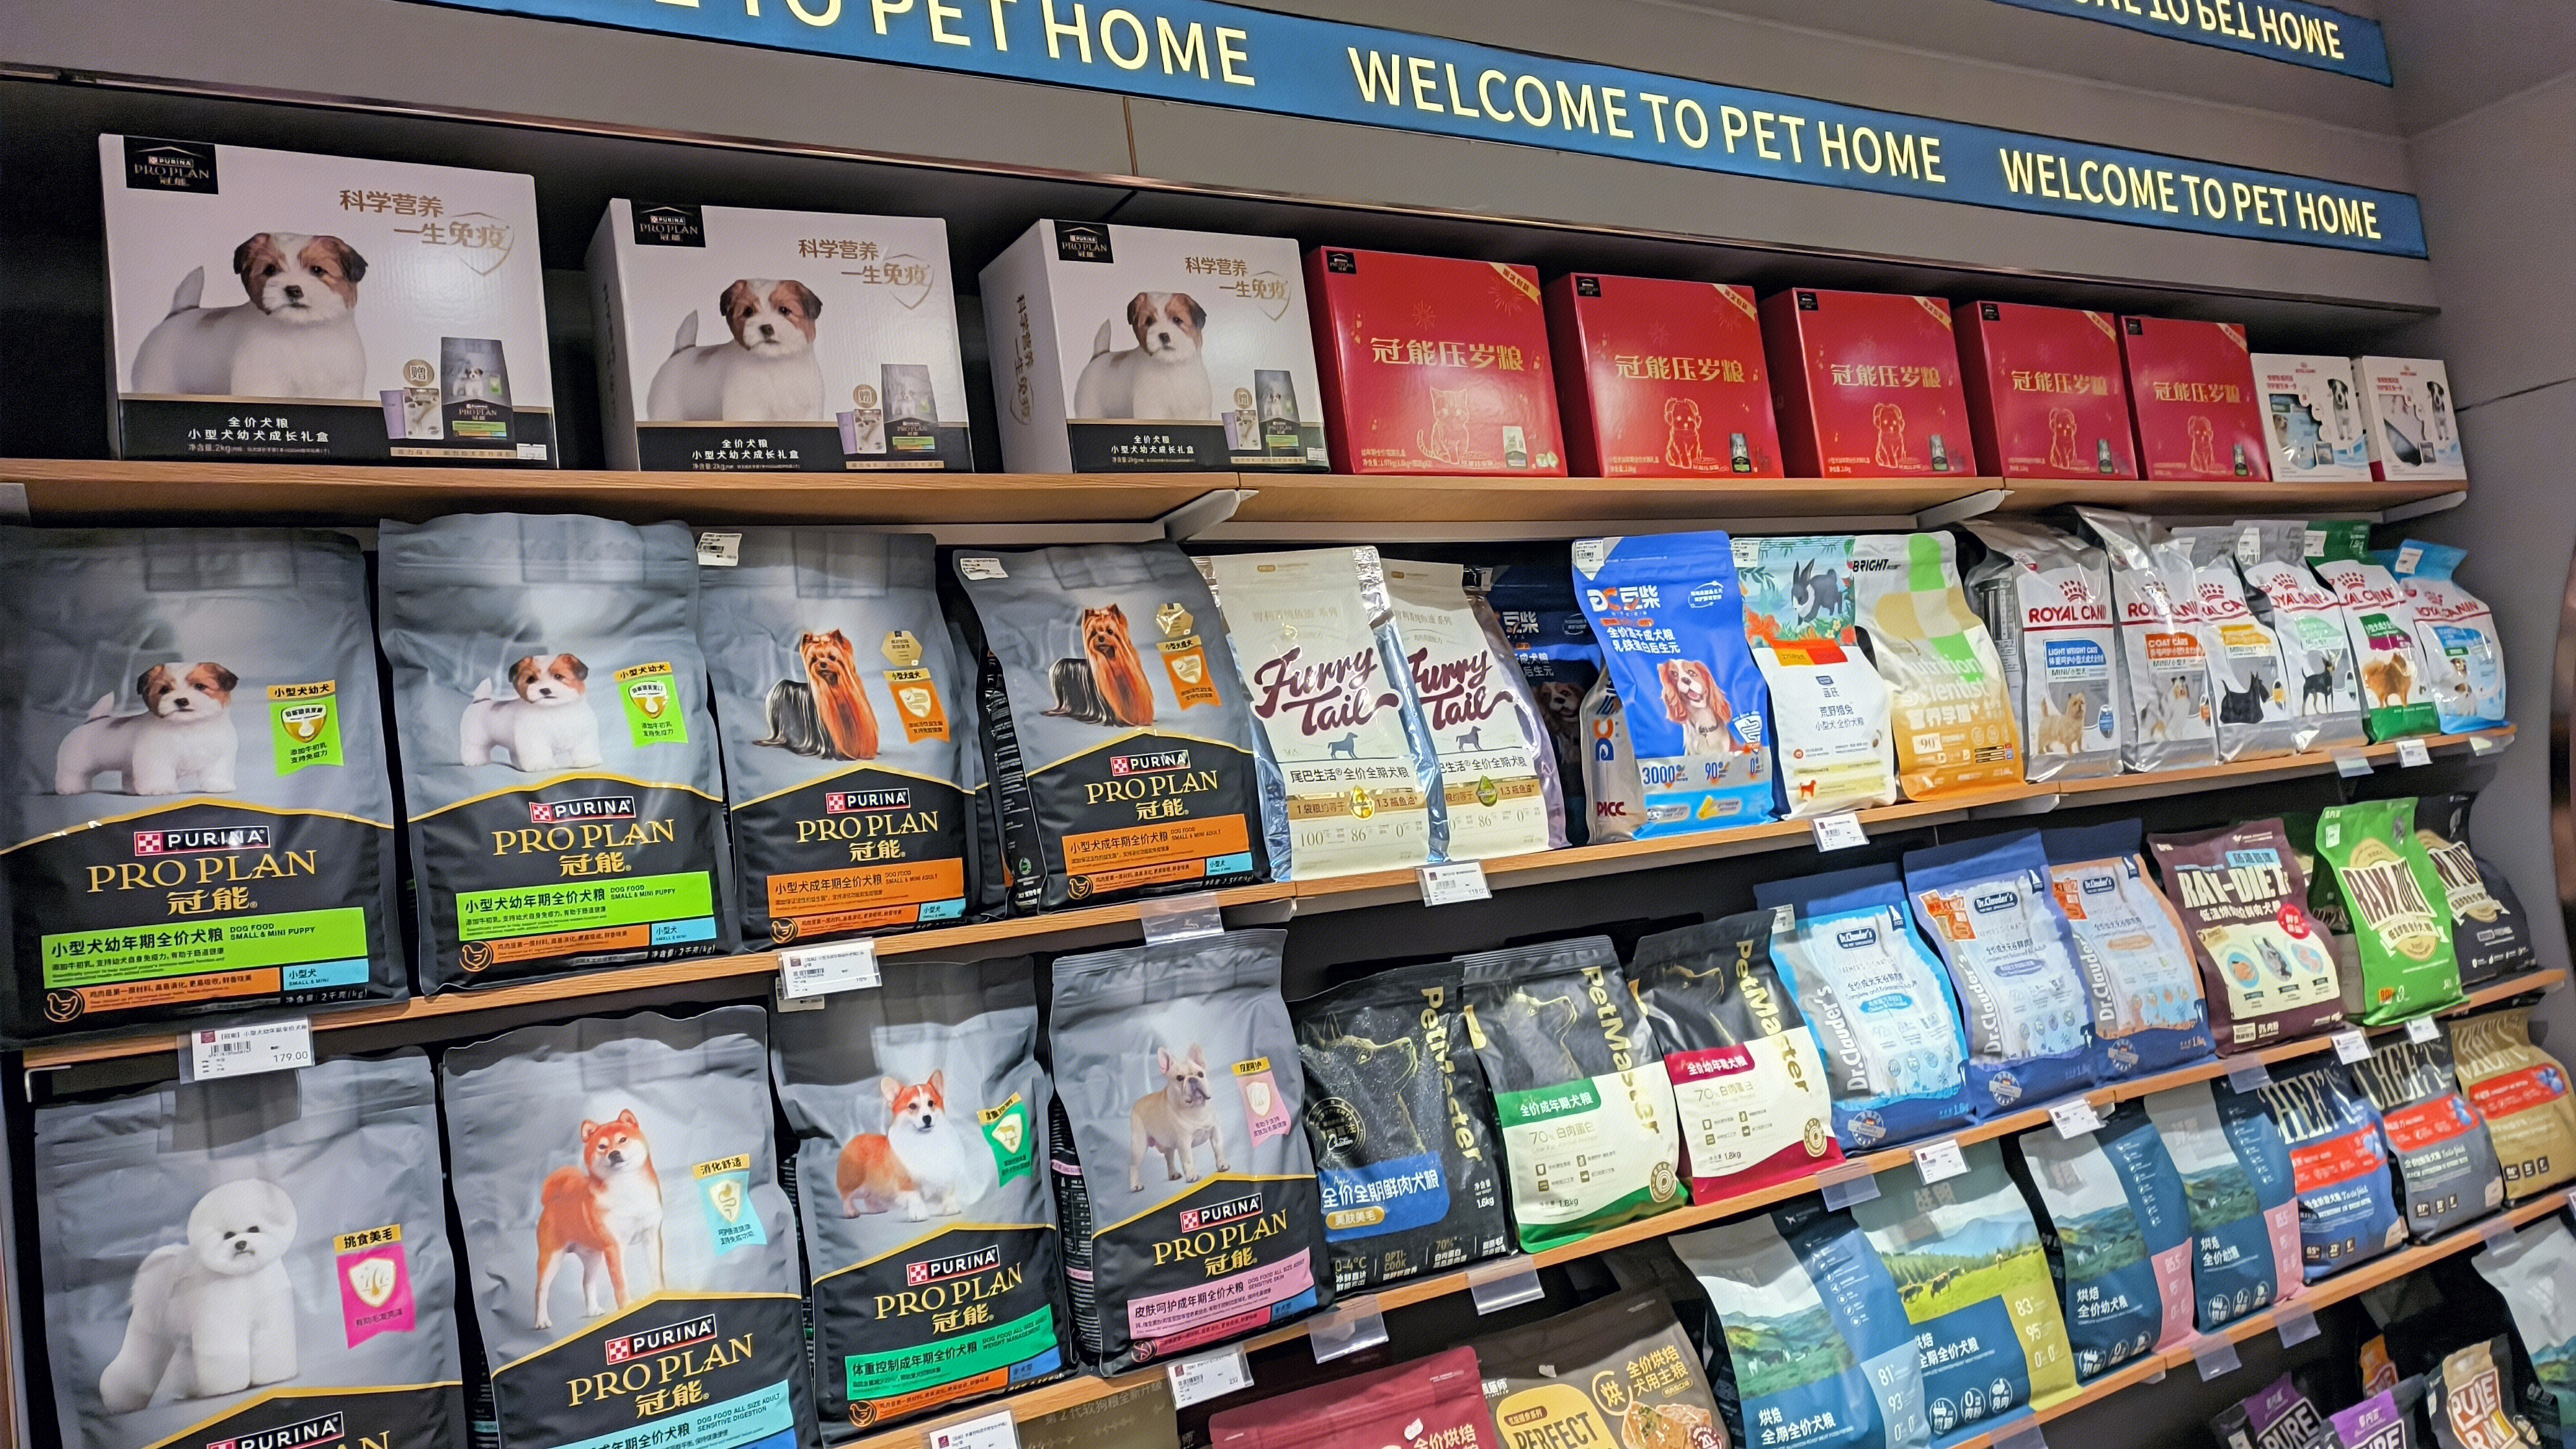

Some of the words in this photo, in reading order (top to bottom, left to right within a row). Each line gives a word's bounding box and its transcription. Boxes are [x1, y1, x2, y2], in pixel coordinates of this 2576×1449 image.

[1044, 3, 1256, 86] HOME
[1348, 46, 1635, 139] WELCOME
[1640, 92, 1709, 149] TO
[1721, 105, 1805, 163] PET
[1818, 120, 1947, 182] HOME
[134, 164, 168, 177] PRO
[169, 166, 210, 180] PLAN
[159, 157, 192, 166] PURINA
[339, 189, 444, 218] 科学营养
[2000, 148, 2179, 213] WELCOME
[2181, 174, 2227, 219] TO
[2232, 182, 2287, 227] PET
[2294, 191, 2381, 240] HOME
[393, 221, 511, 251] 一生免疫
[639, 223, 665, 234] PRO
[667, 224, 698, 236] PLAN
[798, 239, 879, 260] 科学营养
[1083, 242, 1108, 252] PLAN
[841, 262, 931, 286] 一生免疫
[1185, 257, 1248, 277] 科学营养
[1219, 279, 1289, 301] 一生免疫
[1370, 337, 1526, 373] 冠能压岁粮
[1613, 354, 1746, 384] 冠能压岁粮
[1830, 364, 1942, 389] 冠能压岁粮
[2011, 371, 2109, 397] 冠能压岁粮
[2153, 382, 2241, 404] 冠能压岁粮
[228, 416, 290, 429] 全价犬粮
[188, 429, 330, 443] 小型犬幼犬成长礼盒
[721, 438, 769, 449] 全价犬粮
[1133, 435, 1170, 445] 全价犬粮
[692, 449, 800, 460] 小型犬幼犬成长礼盒
[1111, 445, 1195, 454] 小型犬幼犬成长礼盒
[1852, 558, 1889, 573] BRIGHT
[1619, 585, 1661, 612] 豆柴
[2029, 605, 2079, 623] ROYAL
[1607, 626, 1676, 641] 全价冻干成犬粮
[2148, 639, 2170, 648] COAT
[1613, 639, 1681, 654] 乳铁蛋白后生元
[2048, 647, 2065, 656] LIGHT
[2066, 647, 2085, 655] WEIGHT
[618, 663, 669, 680] 小型犬幼犬
[1253, 645, 1378, 720] Furry
[273, 684, 330, 698] 小型犬幼犬
[1281, 685, 1400, 737] Tail
[1422, 685, 1515, 732] Tail
[1815, 719, 1837, 731] 小型犬
[1837, 716, 1865, 729] 全价犬粮
[1130, 753, 1187, 771] PURINA
[1643, 765, 1676, 785] 3000
[1084, 778, 1146, 805] PRO
[1150, 770, 1219, 797] PLAN
[1500, 785, 1513, 796] 1.3
[554, 799, 630, 818] PURINA
[847, 793, 906, 808] PURINA
[1135, 799, 1185, 821] 冠能
[1376, 797, 1389, 809] 1.3
[1596, 800, 1626, 817] PICC
[491, 826, 575, 856] PRO
[581, 819, 676, 849] PLAN
[796, 815, 861, 843] PRO
[865, 811, 939, 836] PLAN
[167, 830, 264, 850] PURINA
[849, 839, 901, 862] 冠能
[1070, 830, 1169, 854] 小型犬成年期全价犬粮
[86, 860, 186, 893] PRO
[195, 850, 317, 884] PLAN
[559, 851, 625, 877] 冠能
[774, 873, 883, 895] 小型犬成年期全价犬粮
[167, 886, 250, 916] 冠能
[465, 887, 606, 914] 小型犬幼年期全价犬粮
[1975, 892, 2015, 908] Dr.Clauder's
[230, 926, 249, 934] DOG
[251, 923, 275, 932] FOOD
[230, 932, 258, 941] SMALL
[267, 929, 286, 938] MINI
[288, 926, 315, 936] PUPPY
[656, 926, 678, 935] 小型犬
[51, 927, 223, 958] 小型犬幼年期全价犬粮
[288, 969, 317, 980] 小型犬
[1957, 954, 2001, 1053] Dr.Clauder's
[1815, 985, 1869, 1092] Dr.Clauder's
[272, 1050, 308, 1063] 179.00
[1687, 1056, 1748, 1076] 全价幼年期犬粮
[1520, 1092, 1594, 1118] 全价成年期犬粮
[1557, 1121, 1596, 1139] 白肉蛋白
[700, 1157, 743, 1175] 消化舒适
[1724, 1150, 1742, 1161] 1.8kg
[1322, 1169, 1440, 1209] 全价全期鲜肉犬粮
[1201, 1199, 1259, 1222] PURINA
[1476, 1196, 1494, 1209] 1.6kg
[1335, 1210, 1376, 1226] 美肤美毛
[343, 1228, 393, 1250] 挑食美毛
[1152, 1232, 1217, 1265] PRO
[1223, 1209, 1288, 1245] PLAN
[2200, 1237, 2220, 1253] 烘焙
[931, 1252, 996, 1278] PURINA
[1205, 1248, 1254, 1278] 冠能
[1385, 1251, 1407, 1263] OPTI-
[1385, 1260, 1407, 1272] COOK
[874, 1287, 947, 1320] PRO
[951, 1262, 1023, 1306] PLAN
[1135, 1282, 1245, 1319] 皮肤呵护成年期全价犬粮
[2077, 1286, 2099, 1302] 烘焙
[2077, 1295, 2129, 1318] 全价幼犬粮
[932, 1302, 989, 1335] 冠能
[633, 1320, 712, 1353] PURINA
[566, 1366, 650, 1406] PRO
[660, 1333, 754, 1384] PLAN
[852, 1341, 978, 1377] 体重控制成年期全价犬粮
[1626, 1345, 1680, 1378] 全价烘焙
[1633, 1361, 1690, 1397] 犬用主粮
[634, 1380, 703, 1418] 冠能
[1600, 1380, 1626, 1408] 烘
[2450, 1375, 2497, 1433] PURE
[697, 1417, 712, 1425] DOG
[713, 1411, 732, 1420] FOOD
[747, 1400, 761, 1410] SIZE
[762, 1393, 780, 1406] ADULT
[697, 1418, 731, 1433] SENSITIVE
[733, 1406, 767, 1422] DIGESTION
[1759, 1406, 1783, 1426] 烘焙
[1414, 1424, 1477, 1449] 全价烘焙
[1513, 1411, 1598, 1449] PERFECT
[1761, 1411, 1837, 1445] 全期全价犬粮
